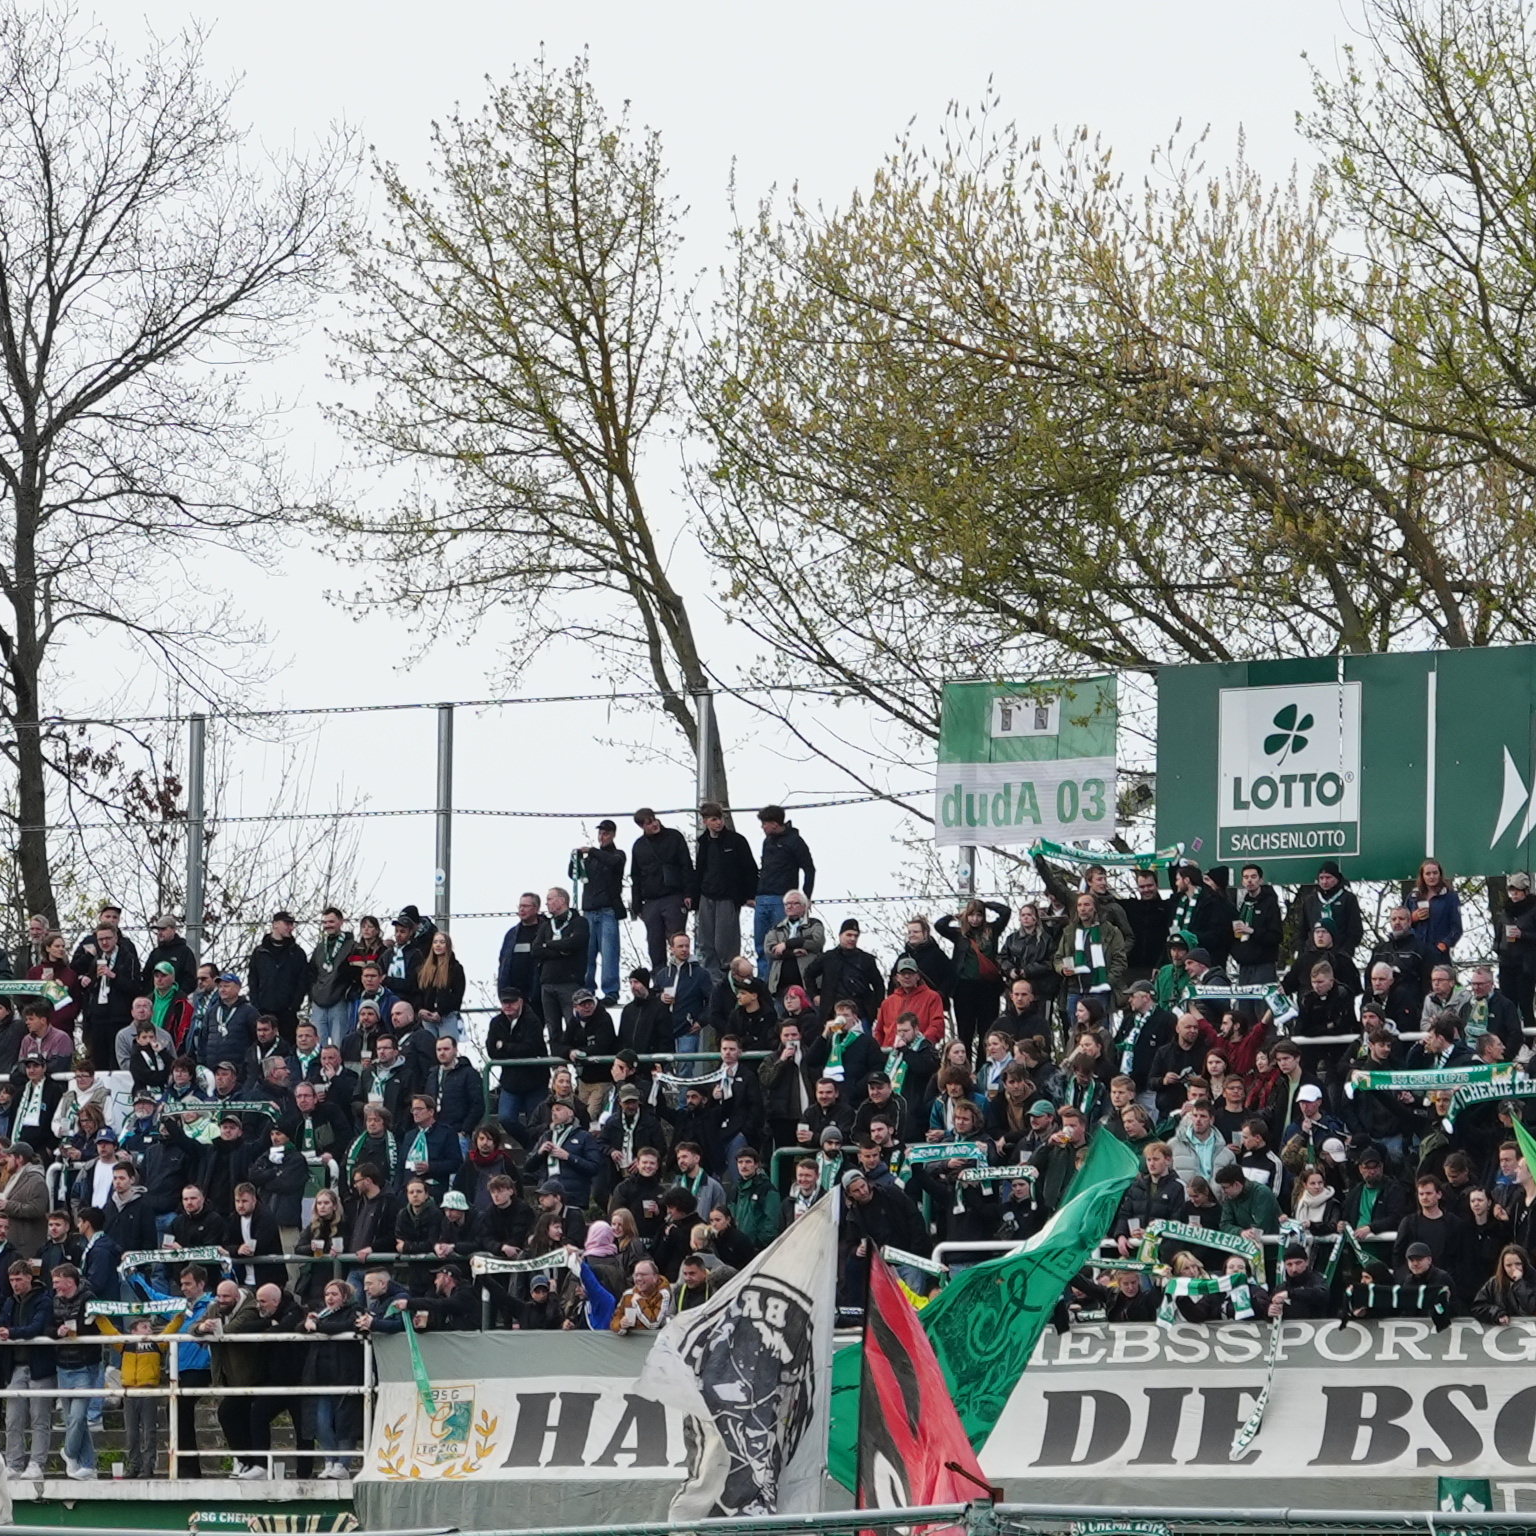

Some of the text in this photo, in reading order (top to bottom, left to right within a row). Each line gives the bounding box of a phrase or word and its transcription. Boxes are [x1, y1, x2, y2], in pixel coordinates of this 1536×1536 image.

[1056, 778, 1106, 823] 03
[1233, 771, 1345, 810] LOTTO
[1231, 830, 1345, 851] SACHSENLOTTO
[1030, 1387, 1265, 1468] DIE
